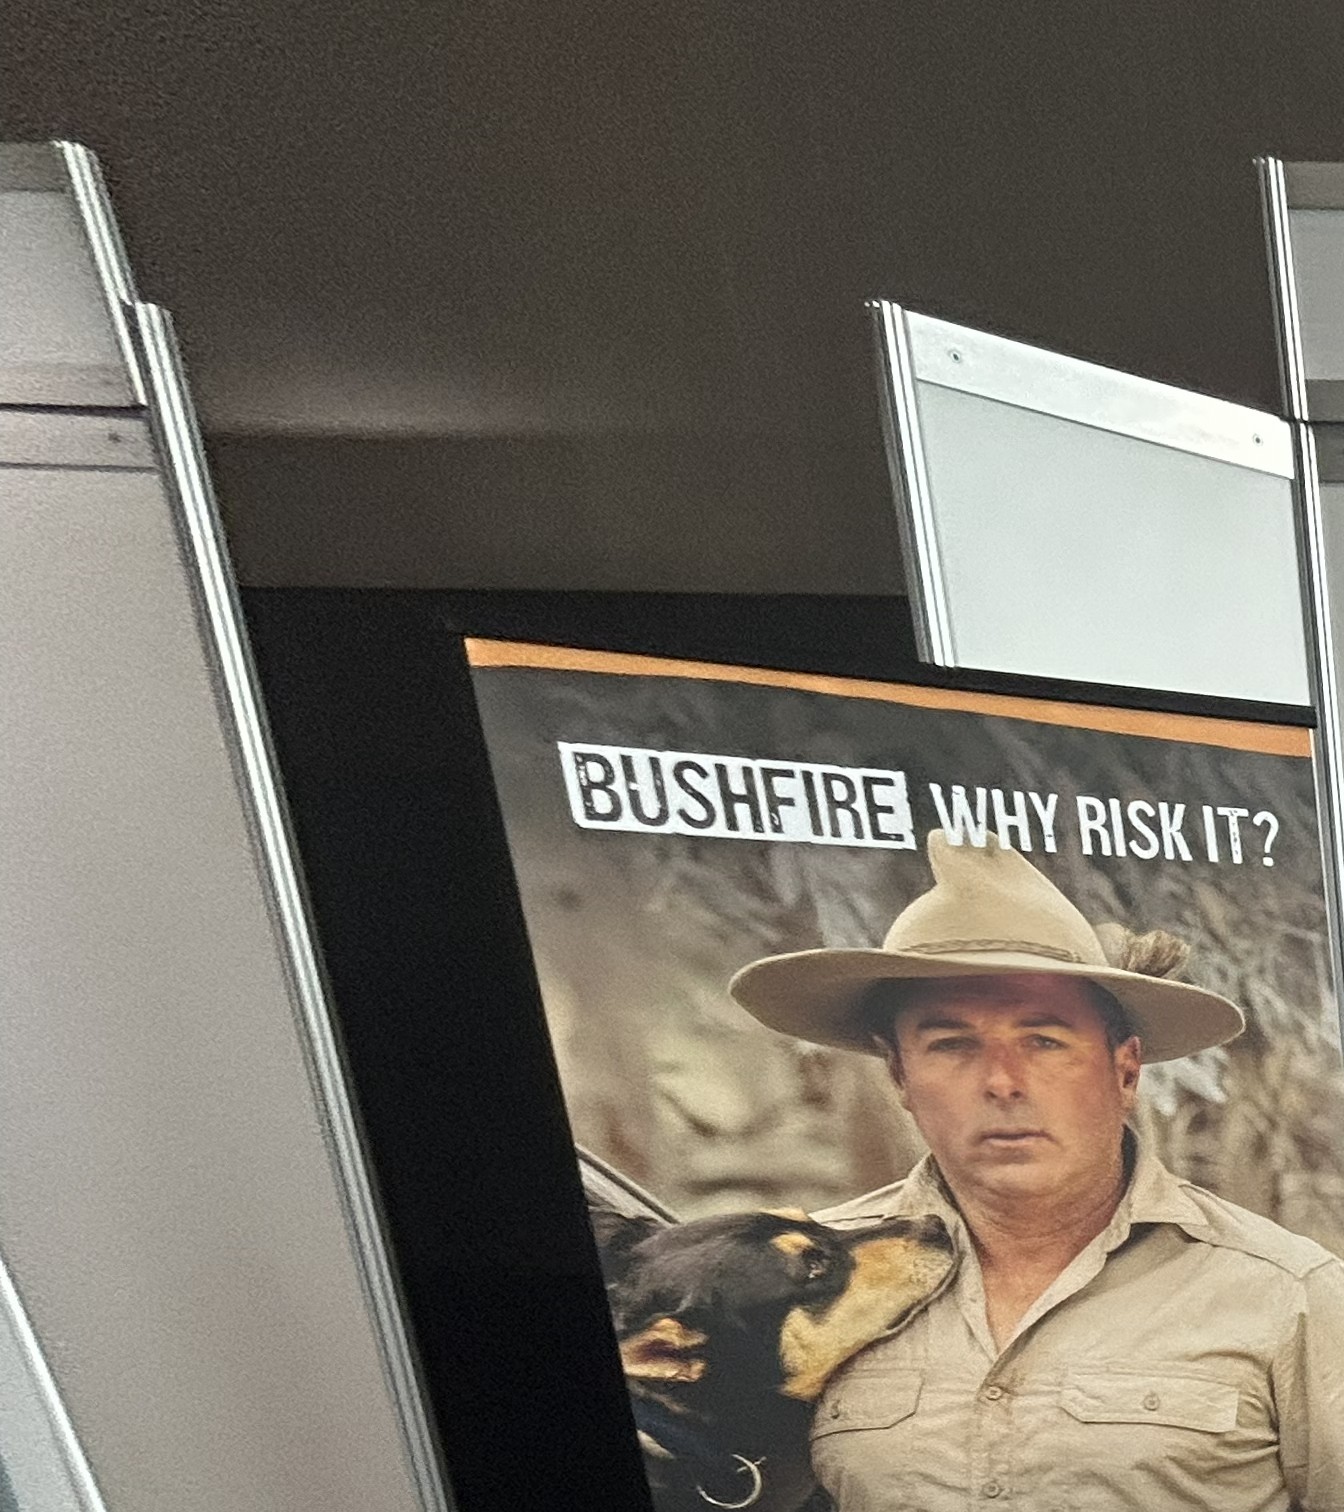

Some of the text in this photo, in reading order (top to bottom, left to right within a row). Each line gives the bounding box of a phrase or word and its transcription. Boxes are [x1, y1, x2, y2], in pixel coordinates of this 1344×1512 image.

[576, 749, 1279, 867] BUSHFIRE WHY RISK IT?
